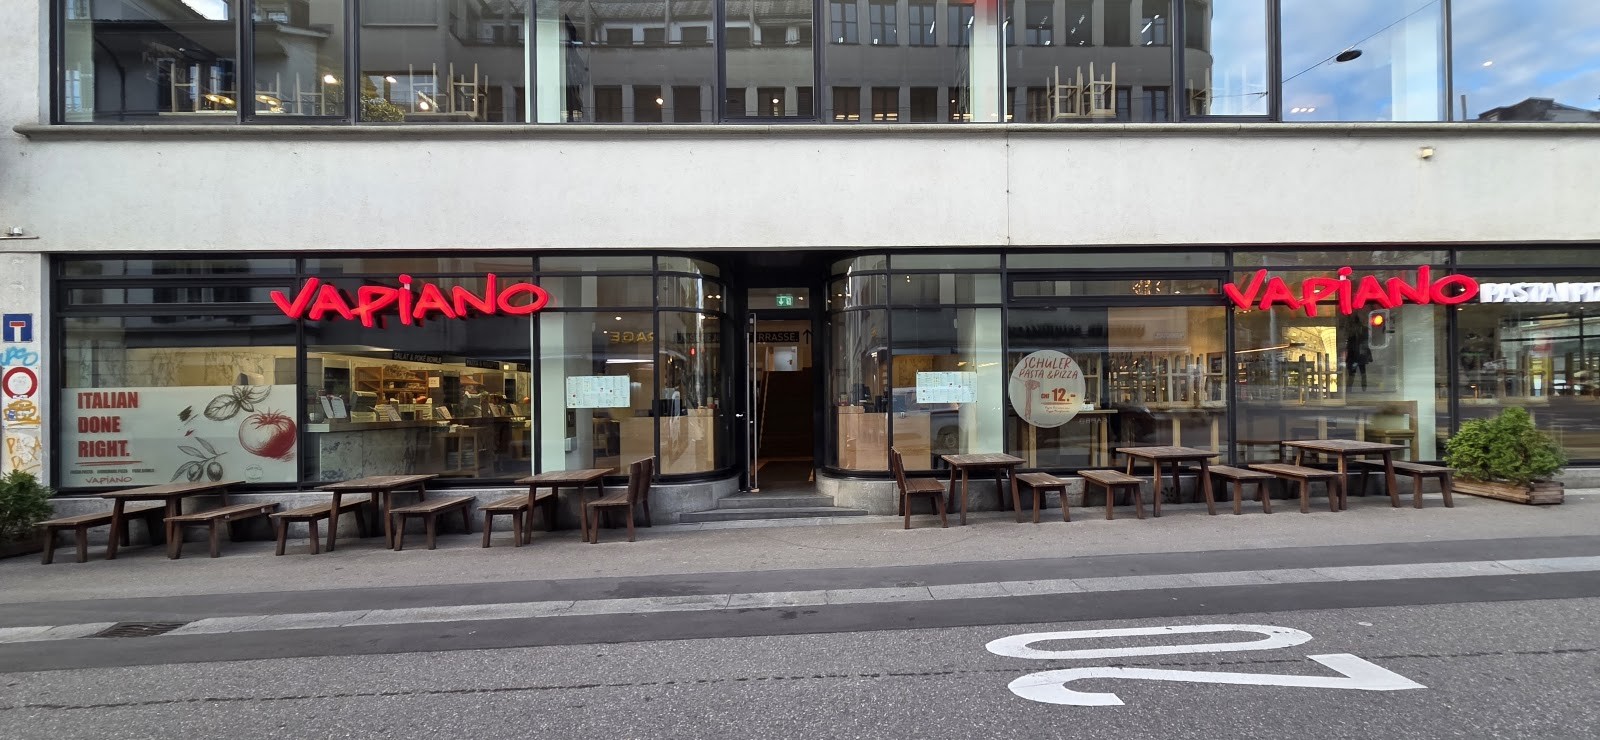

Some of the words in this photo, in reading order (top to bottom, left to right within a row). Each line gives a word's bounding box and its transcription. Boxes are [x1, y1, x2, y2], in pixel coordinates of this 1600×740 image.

[1480, 282, 1557, 303] PASTA
[1018, 368, 1045, 379] PASTA
[78, 392, 139, 408] ITALIAN
[78, 416, 121, 433] DONE
[78, 440, 130, 457] RIGHT.
[985, 624, 1427, 707] 20
